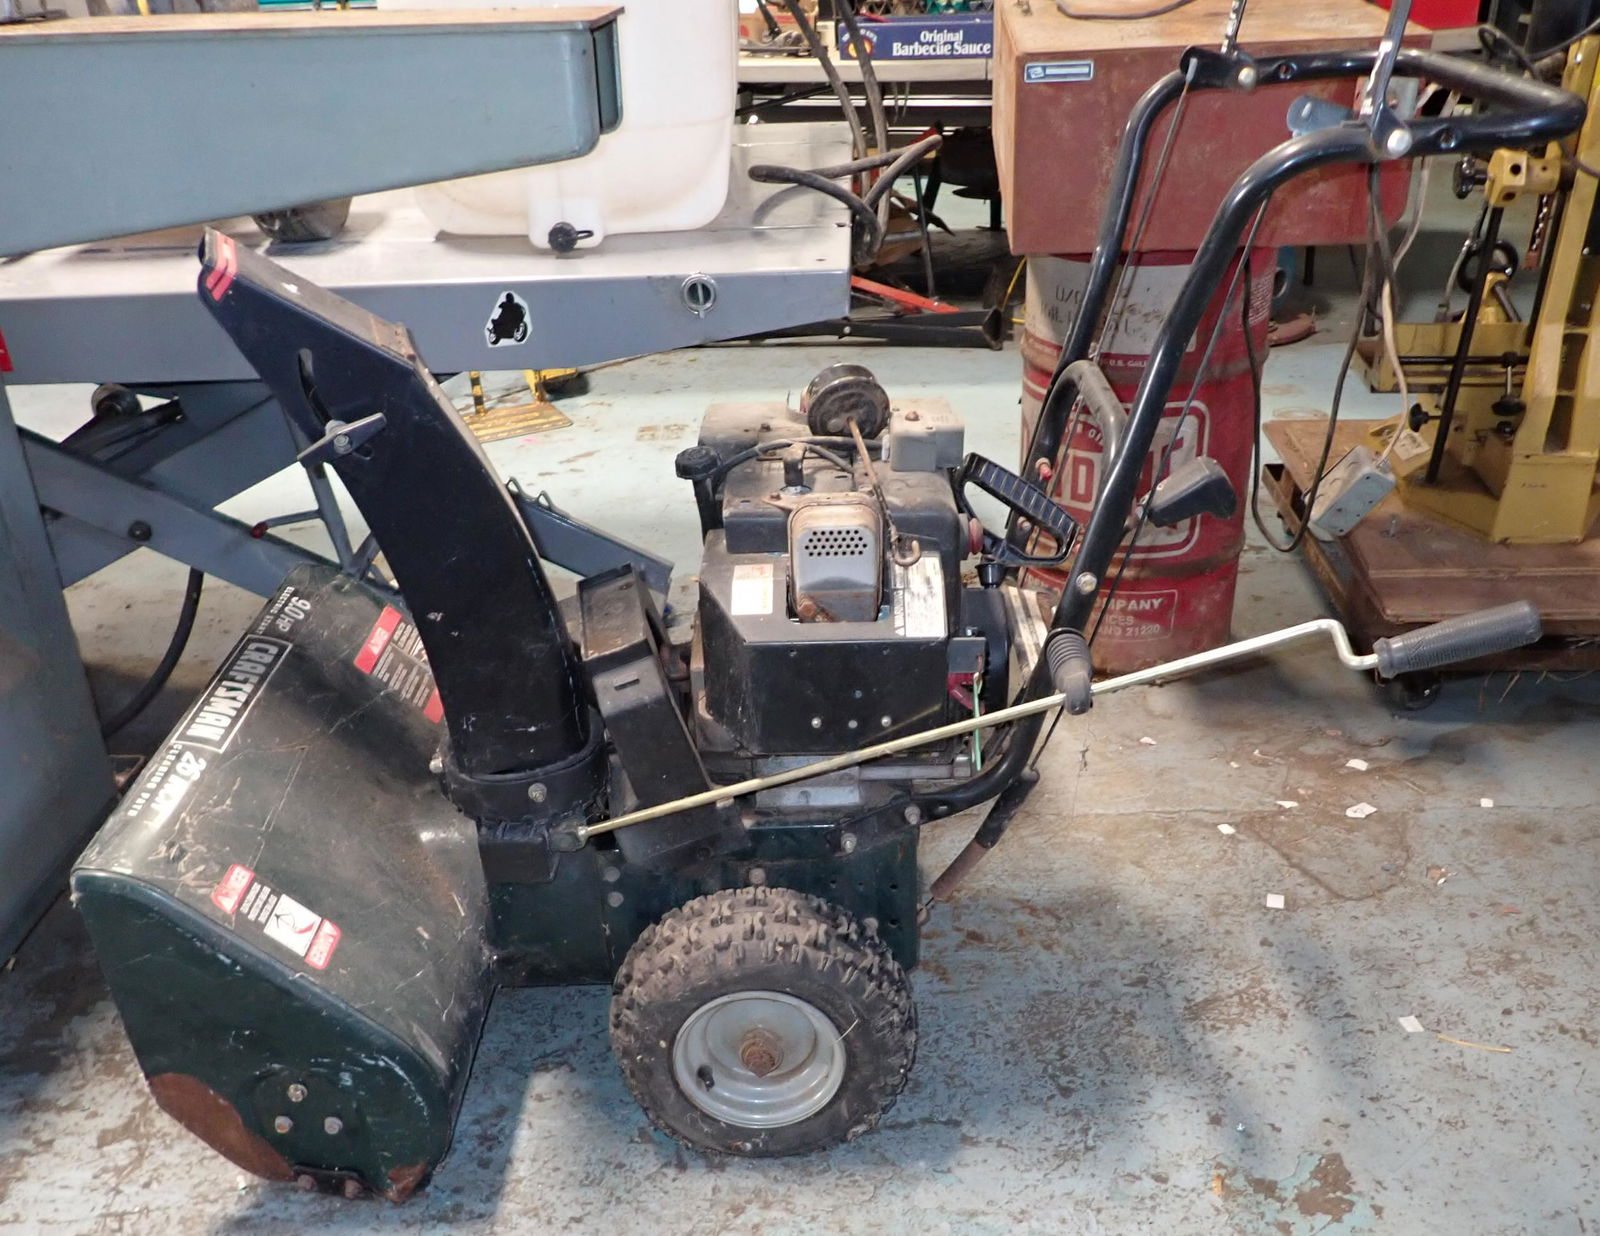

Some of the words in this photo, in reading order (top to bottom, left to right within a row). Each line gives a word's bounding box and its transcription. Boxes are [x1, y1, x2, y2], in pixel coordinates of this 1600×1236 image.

[920, 29, 963, 45] Original
[892, 42, 952, 56] Barbecue
[953, 41, 991, 55] Sauce
[284, 596, 311, 620] 9.0
[276, 613, 295, 632] HP
[186, 642, 279, 742] CRAFTSMAN
